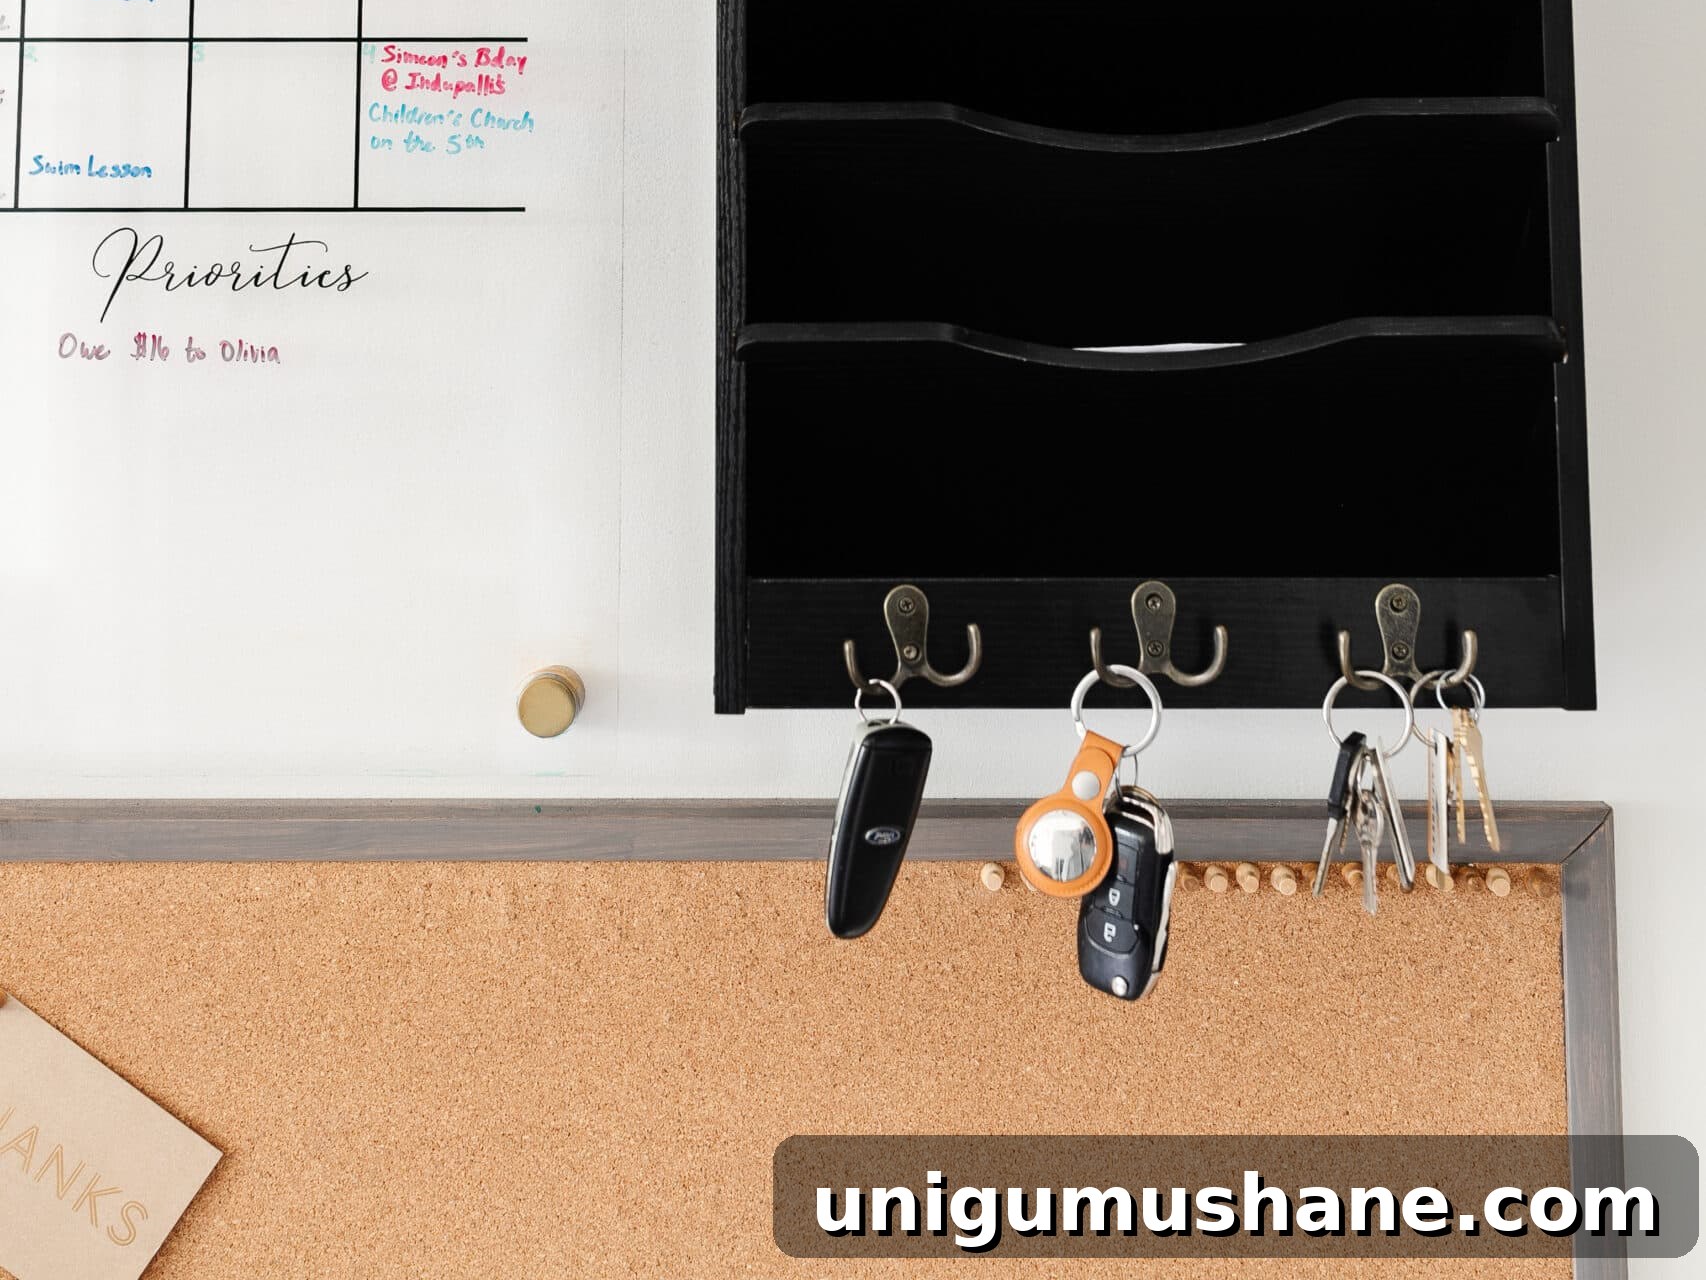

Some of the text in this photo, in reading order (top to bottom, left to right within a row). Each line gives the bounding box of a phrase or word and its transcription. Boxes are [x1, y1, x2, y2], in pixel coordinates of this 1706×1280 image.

[474, 45, 528, 75] Bday
[381, 67, 398, 92] @
[28, 154, 152, 179] Swim Lesson
[92, 227, 369, 323] Priorities
[58, 332, 111, 361] Owe
[185, 336, 207, 363] to
[219, 338, 281, 365] Olivia
